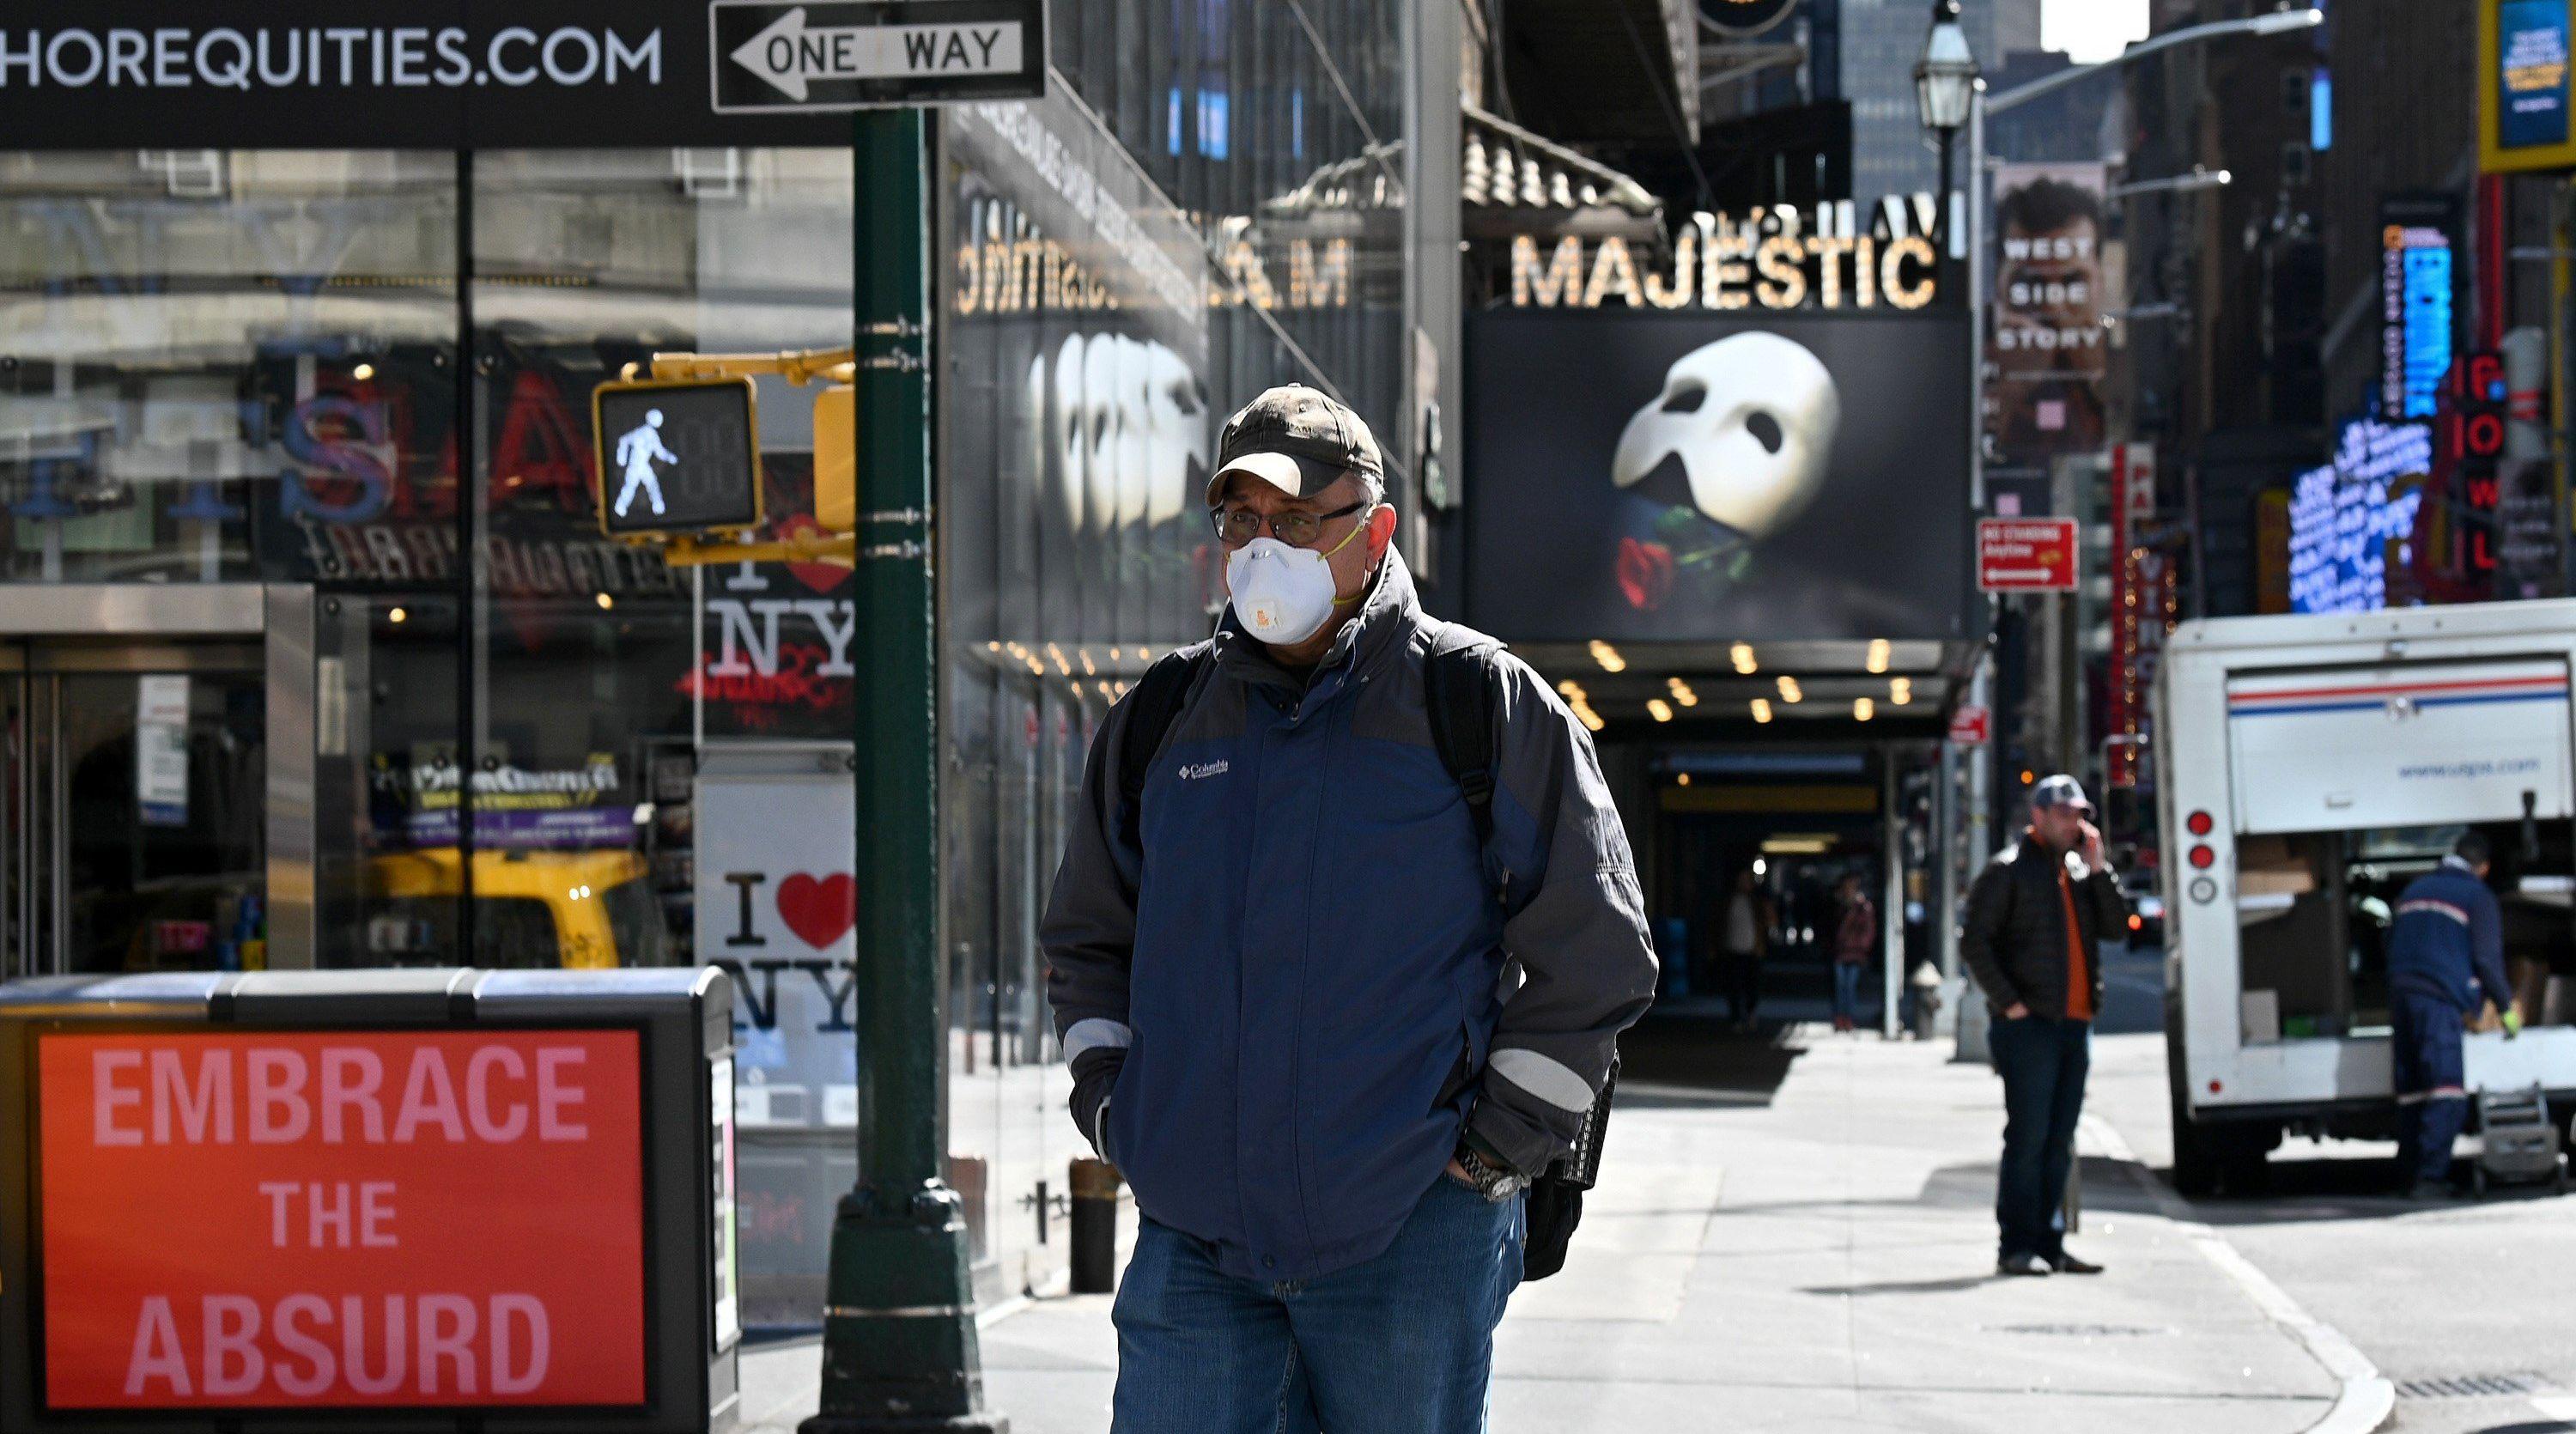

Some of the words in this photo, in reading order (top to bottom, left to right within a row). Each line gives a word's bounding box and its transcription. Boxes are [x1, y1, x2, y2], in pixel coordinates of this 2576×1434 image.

[0, 27, 662, 89] HOREQUITIES.COM
[766, 34, 856, 74] ONE
[904, 27, 1000, 70] WAY
[1511, 234, 1935, 309] MAJESTIC
[2003, 237, 2093, 259] WEST
[2009, 281, 2088, 306] SIDE
[1996, 326, 2102, 351] STORY
[707, 599, 855, 678] NY
[1190, 758, 1228, 775] Columbia
[726, 872, 767, 946] I
[92, 1046, 588, 1147] EMBRACE
[259, 1182, 398, 1249] THE
[123, 1293, 550, 1398] ABSURD
